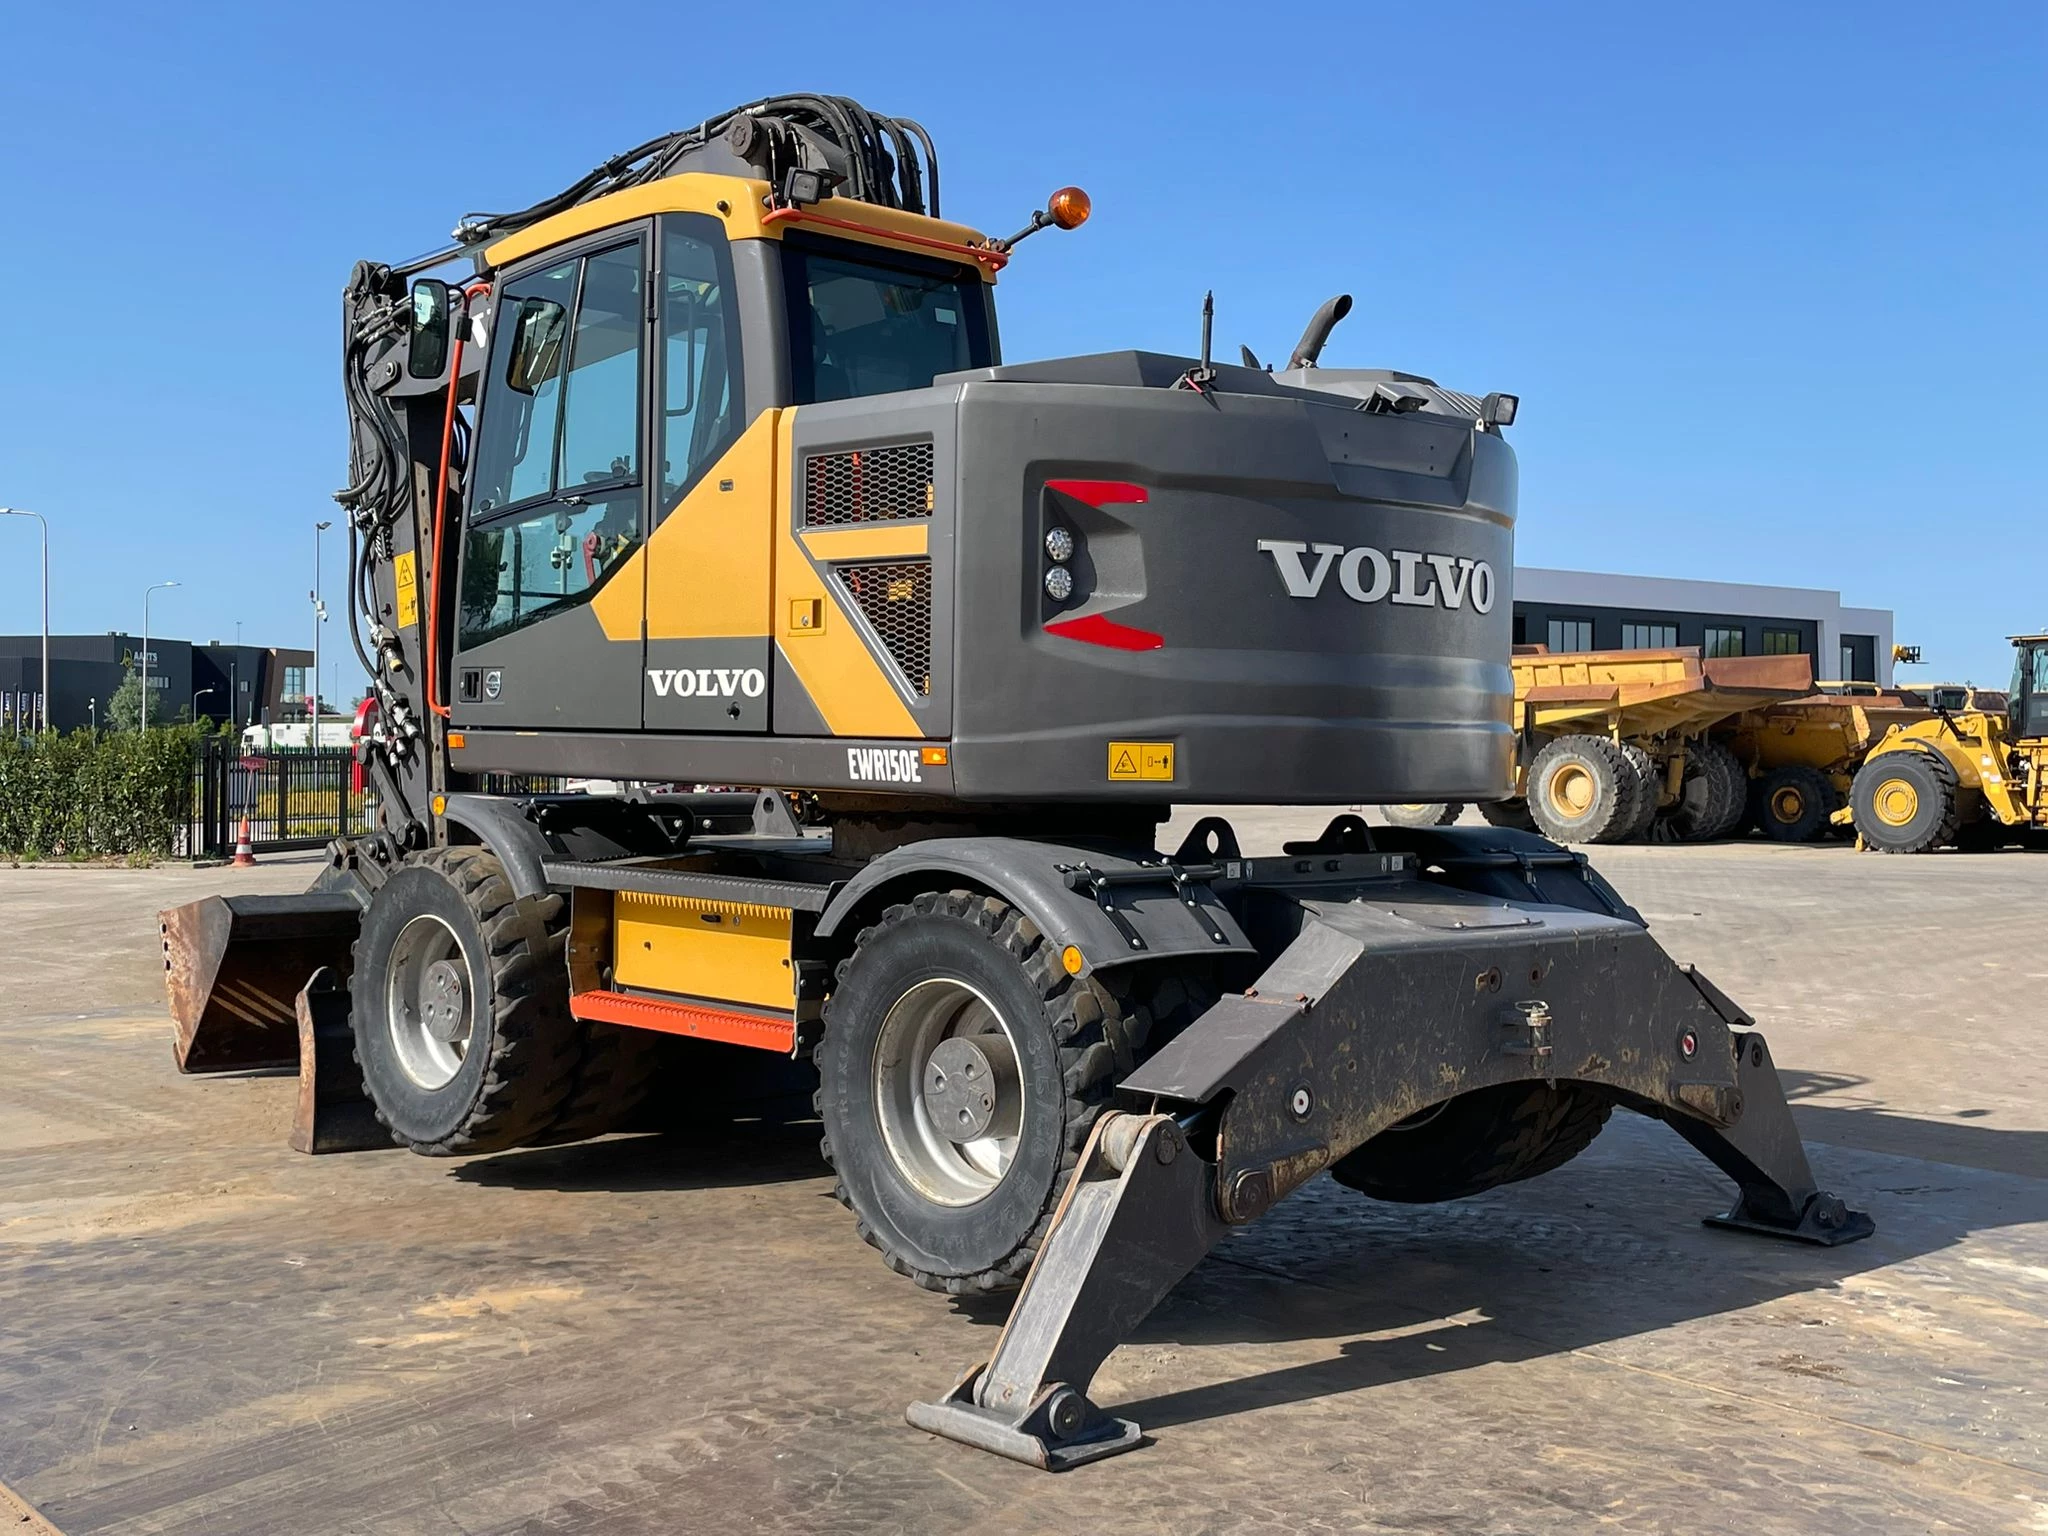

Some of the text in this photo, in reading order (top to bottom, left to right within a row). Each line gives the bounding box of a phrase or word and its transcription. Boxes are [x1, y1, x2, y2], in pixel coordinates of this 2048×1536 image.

[1257, 539, 1495, 614] VOLVO
[647, 668, 766, 698] VOLVO
[847, 748, 922, 783] EWR150E
